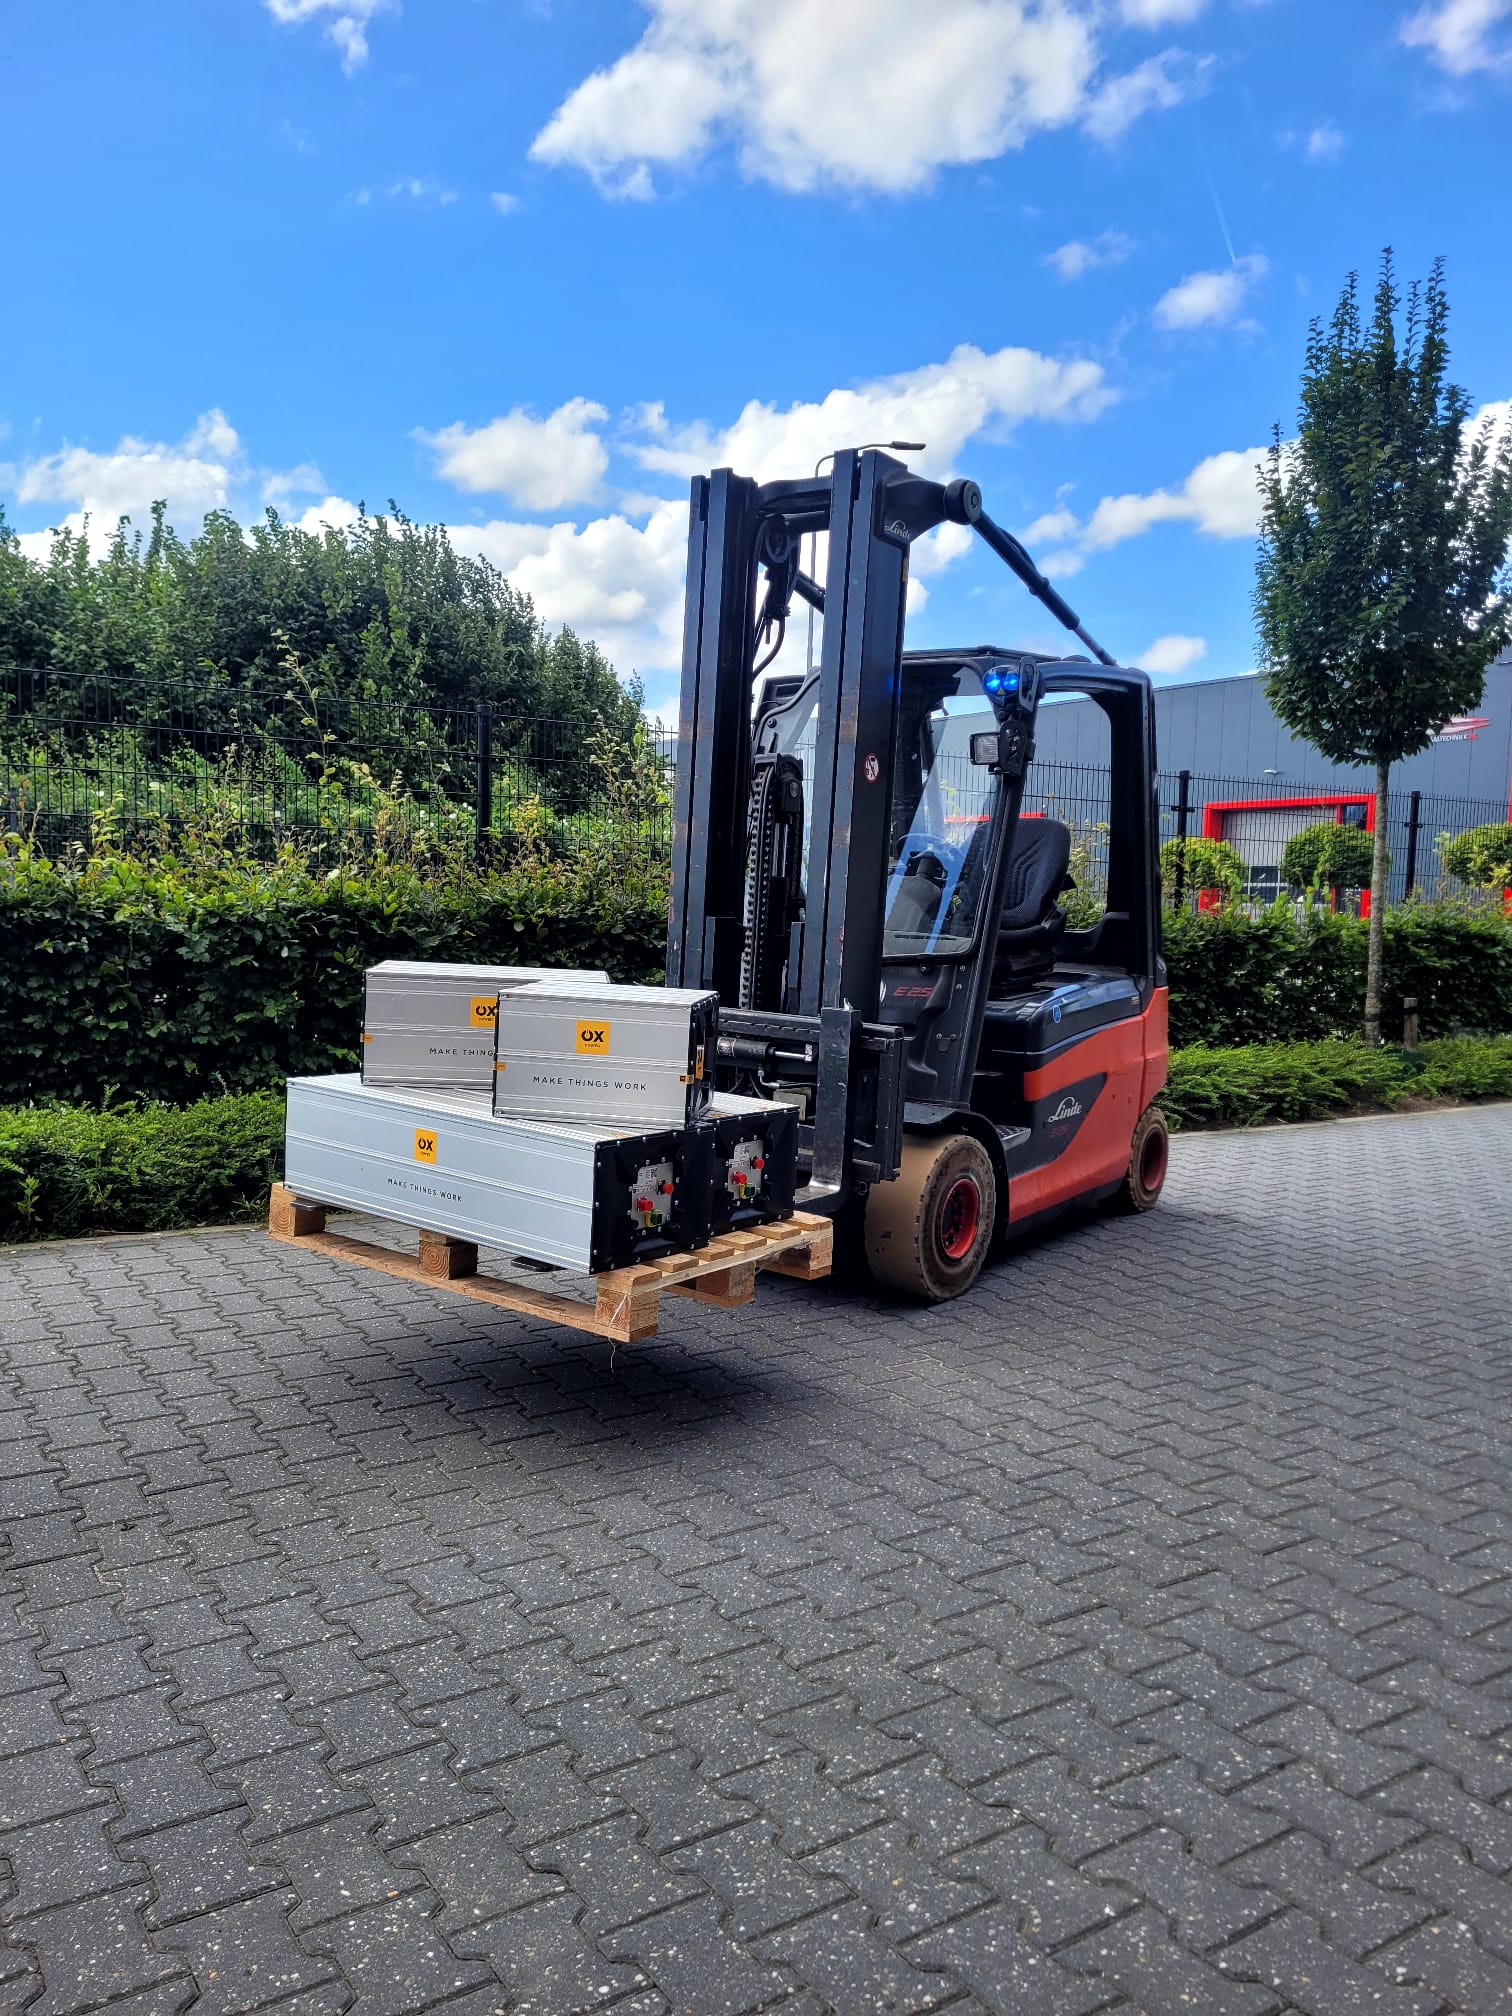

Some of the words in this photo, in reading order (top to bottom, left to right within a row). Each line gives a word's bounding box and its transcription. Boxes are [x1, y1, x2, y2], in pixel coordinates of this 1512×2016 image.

[475, 1004, 497, 1016] OX
[581, 1028, 605, 1043] OX
[429, 1047, 458, 1056] MAKE
[463, 1049, 495, 1057] THING
[533, 1075, 563, 1085] MAKE
[568, 1078, 609, 1088] THINGS
[614, 1081, 647, 1091] WORK
[1048, 1096, 1082, 1123] Linde
[418, 1137, 434, 1152] OX
[387, 1178, 407, 1189] MAKE
[410, 1183, 437, 1196] THINGS
[440, 1190, 462, 1203] WORK
